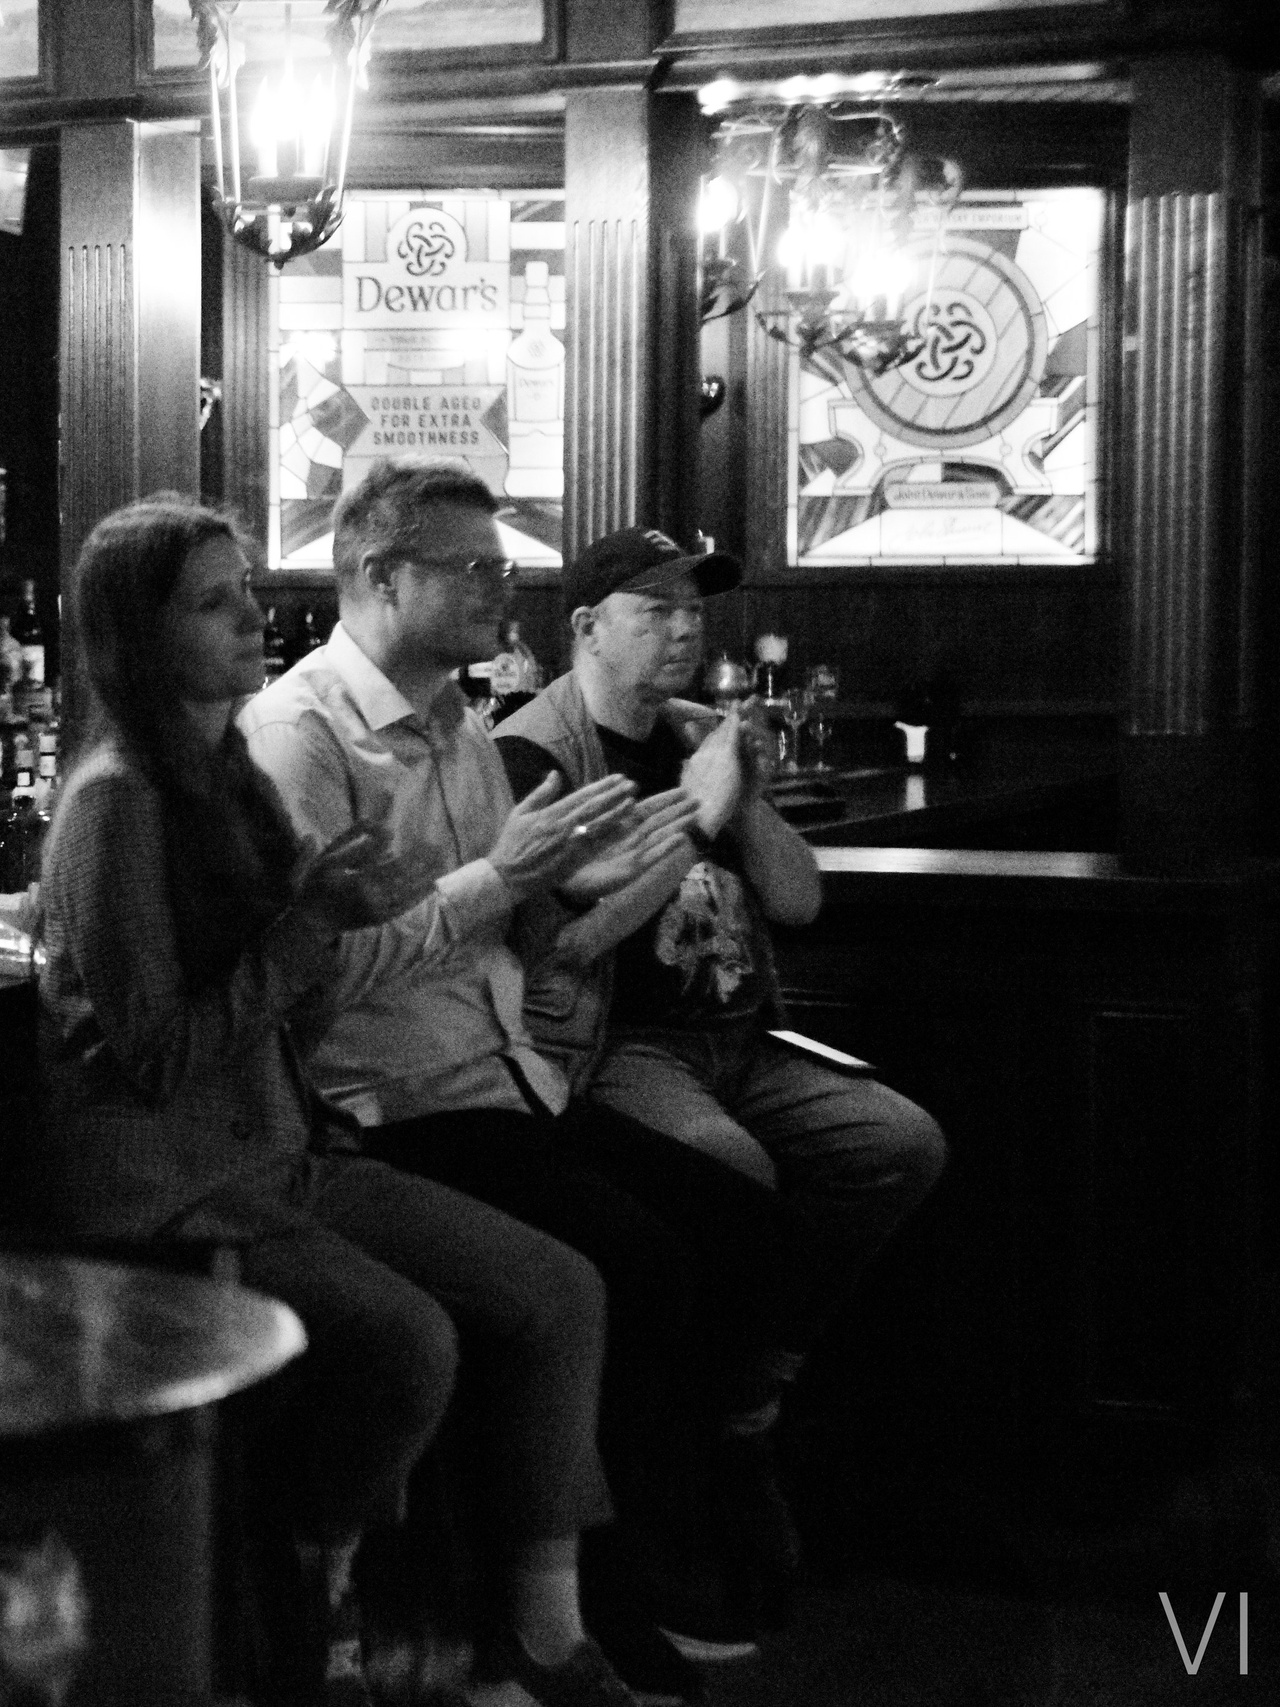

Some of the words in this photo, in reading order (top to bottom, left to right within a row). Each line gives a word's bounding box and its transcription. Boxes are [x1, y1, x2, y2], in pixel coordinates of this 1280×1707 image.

[356, 275, 498, 313] Dewar's
[370, 396, 431, 411] DOUBLE
[440, 396, 481, 411] AGED
[380, 414, 410, 428] FOR
[418, 414, 472, 428] EXTRA
[373, 430, 480, 446] SMOOTHNESS
